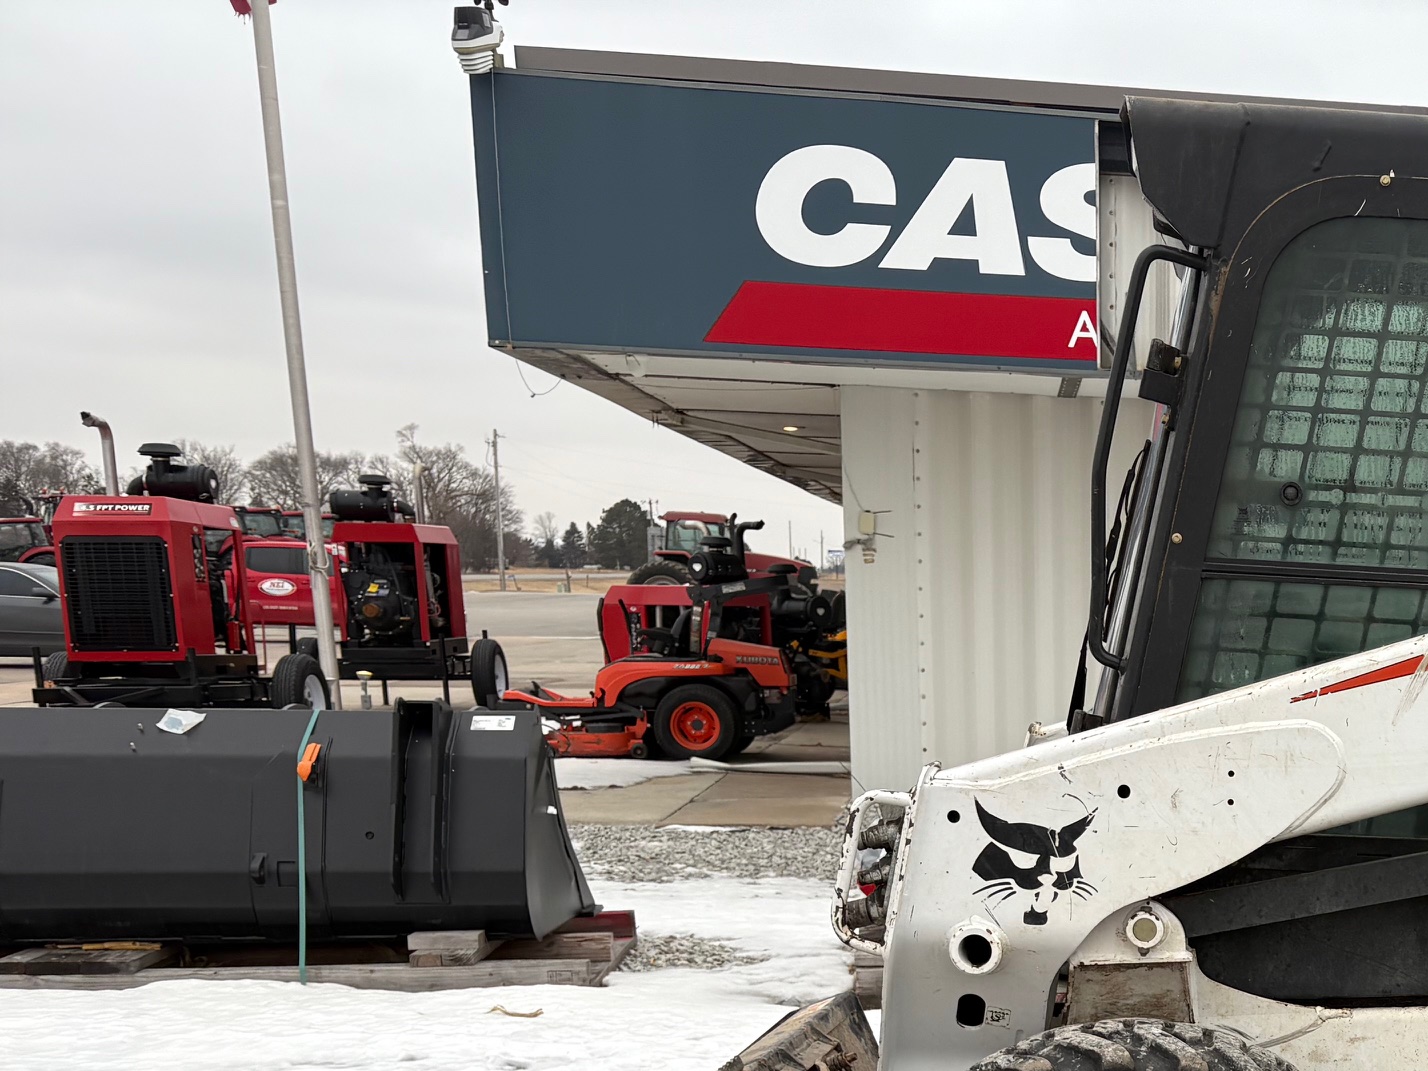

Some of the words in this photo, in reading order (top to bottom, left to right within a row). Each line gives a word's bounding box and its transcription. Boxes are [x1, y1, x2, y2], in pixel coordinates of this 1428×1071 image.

[96, 504, 114, 512] FPT
[114, 504, 150, 512] POWER
[735, 655, 780, 666] KUBOTA
